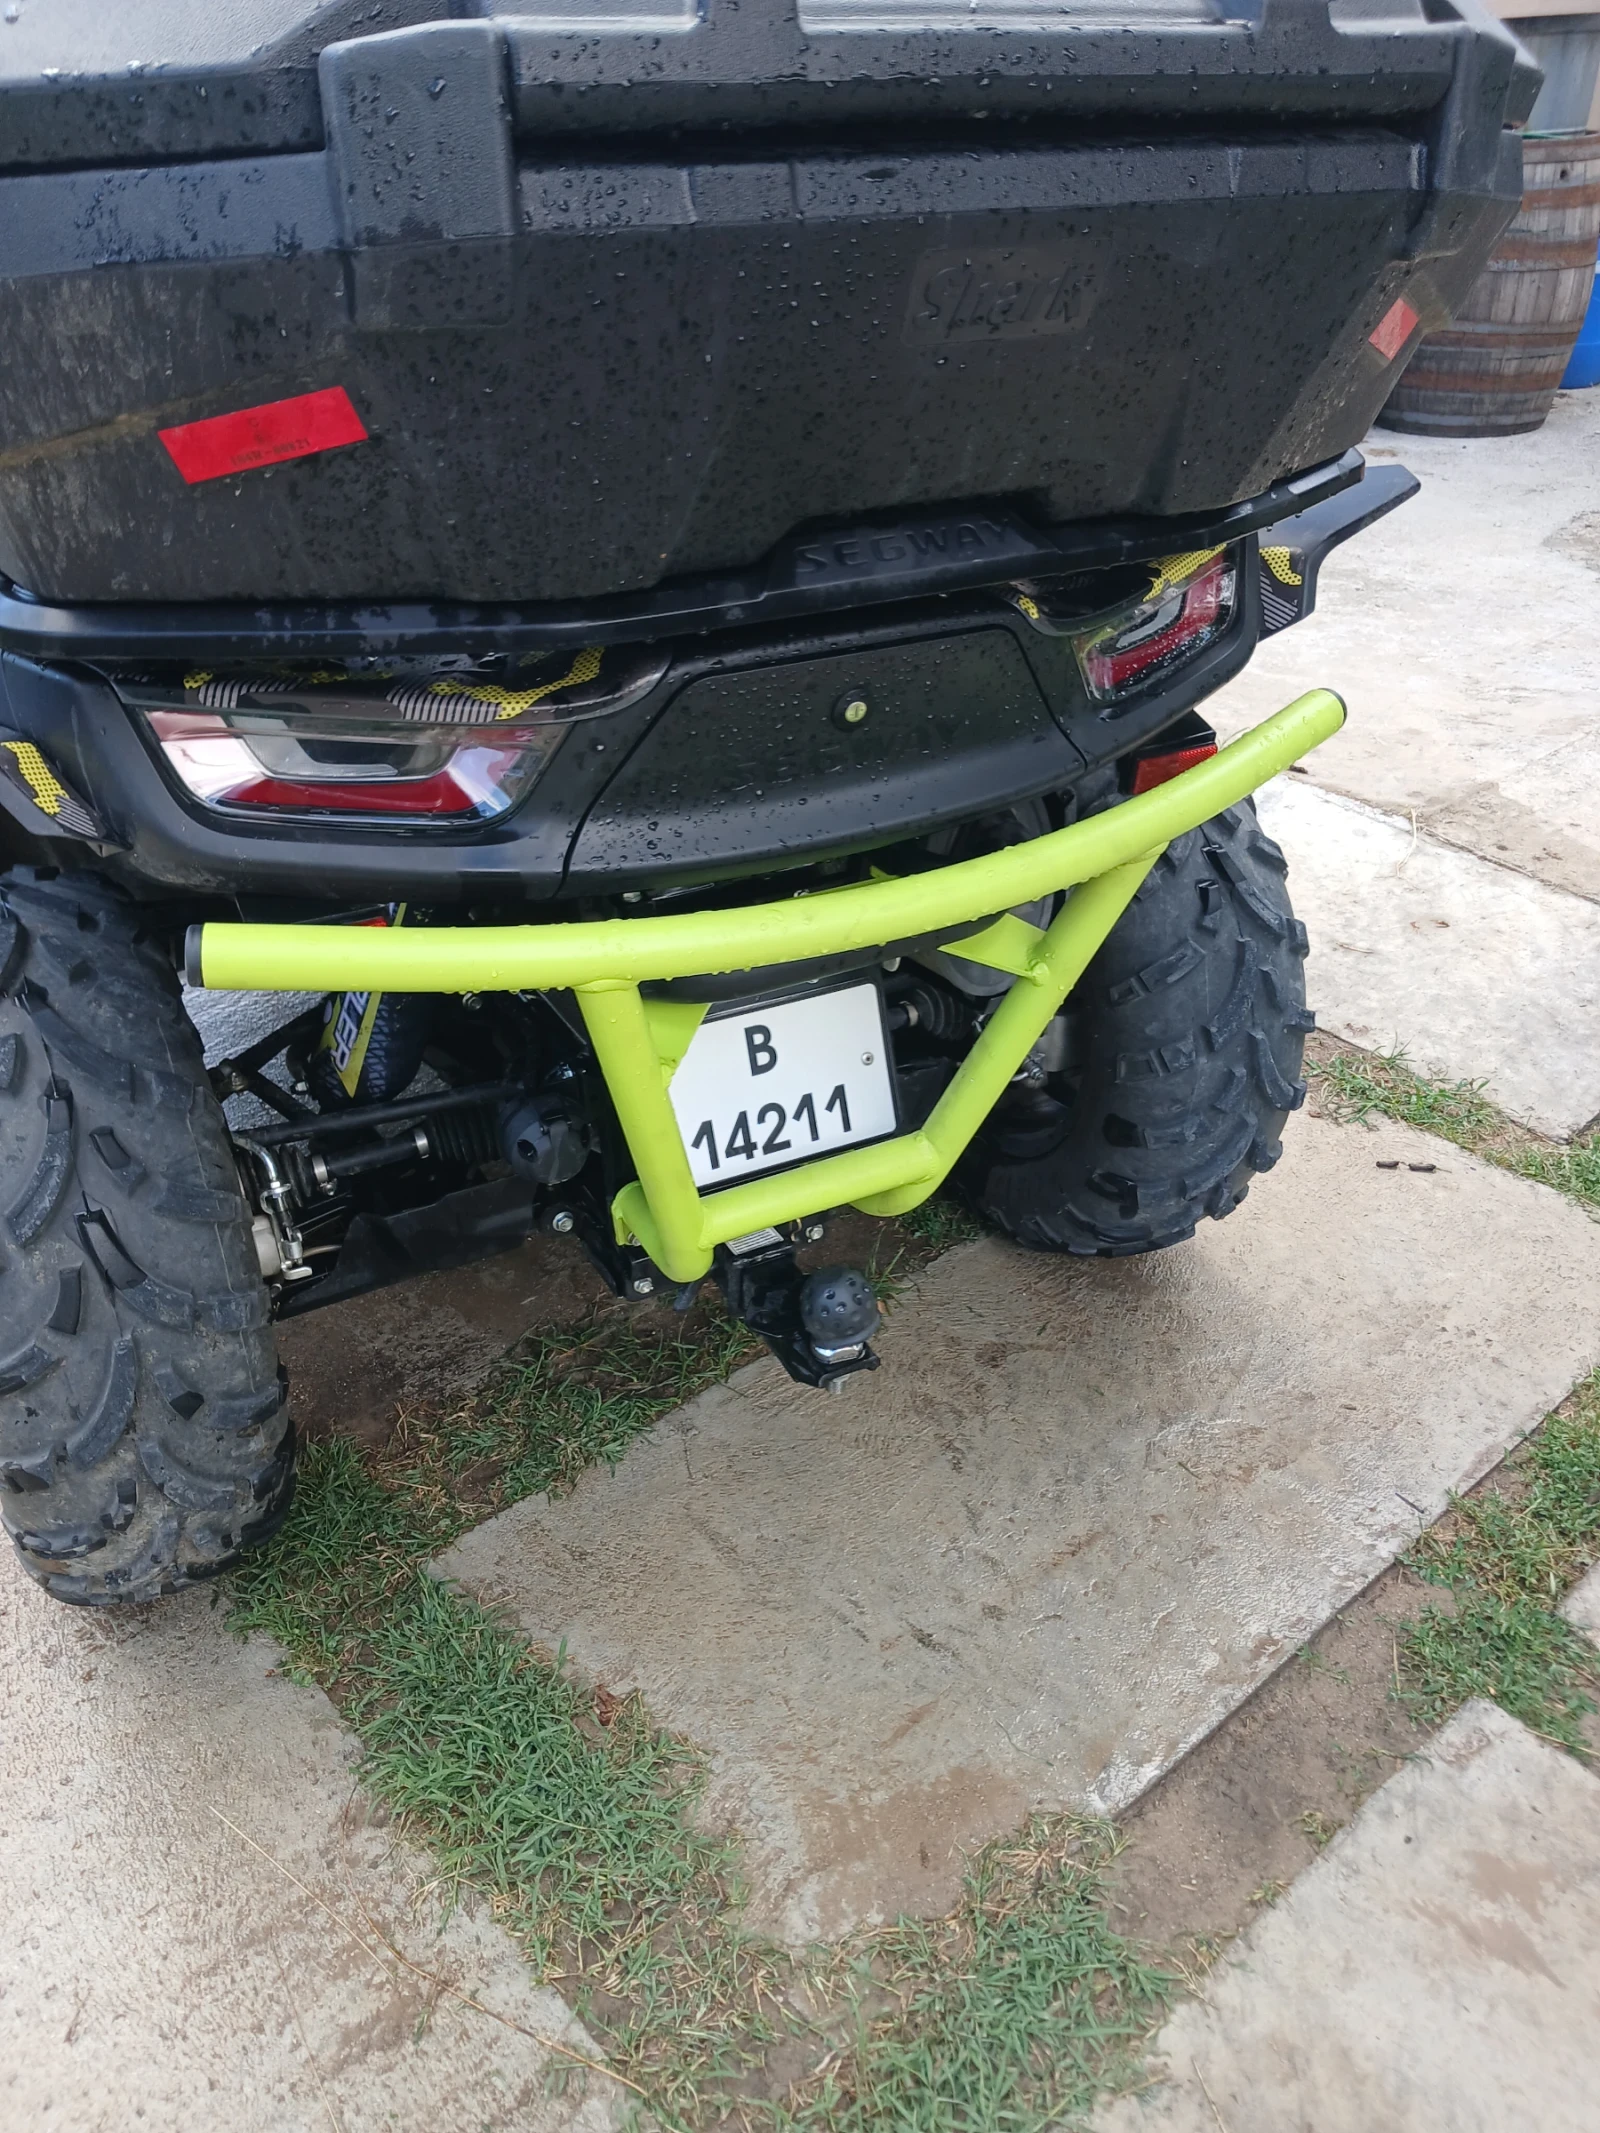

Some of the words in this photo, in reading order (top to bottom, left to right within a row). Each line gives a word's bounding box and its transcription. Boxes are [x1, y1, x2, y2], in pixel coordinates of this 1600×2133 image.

[794, 520, 1009, 575] SEGWAY
[744, 1024, 778, 1077] B
[690, 1083, 852, 1170] 14211
